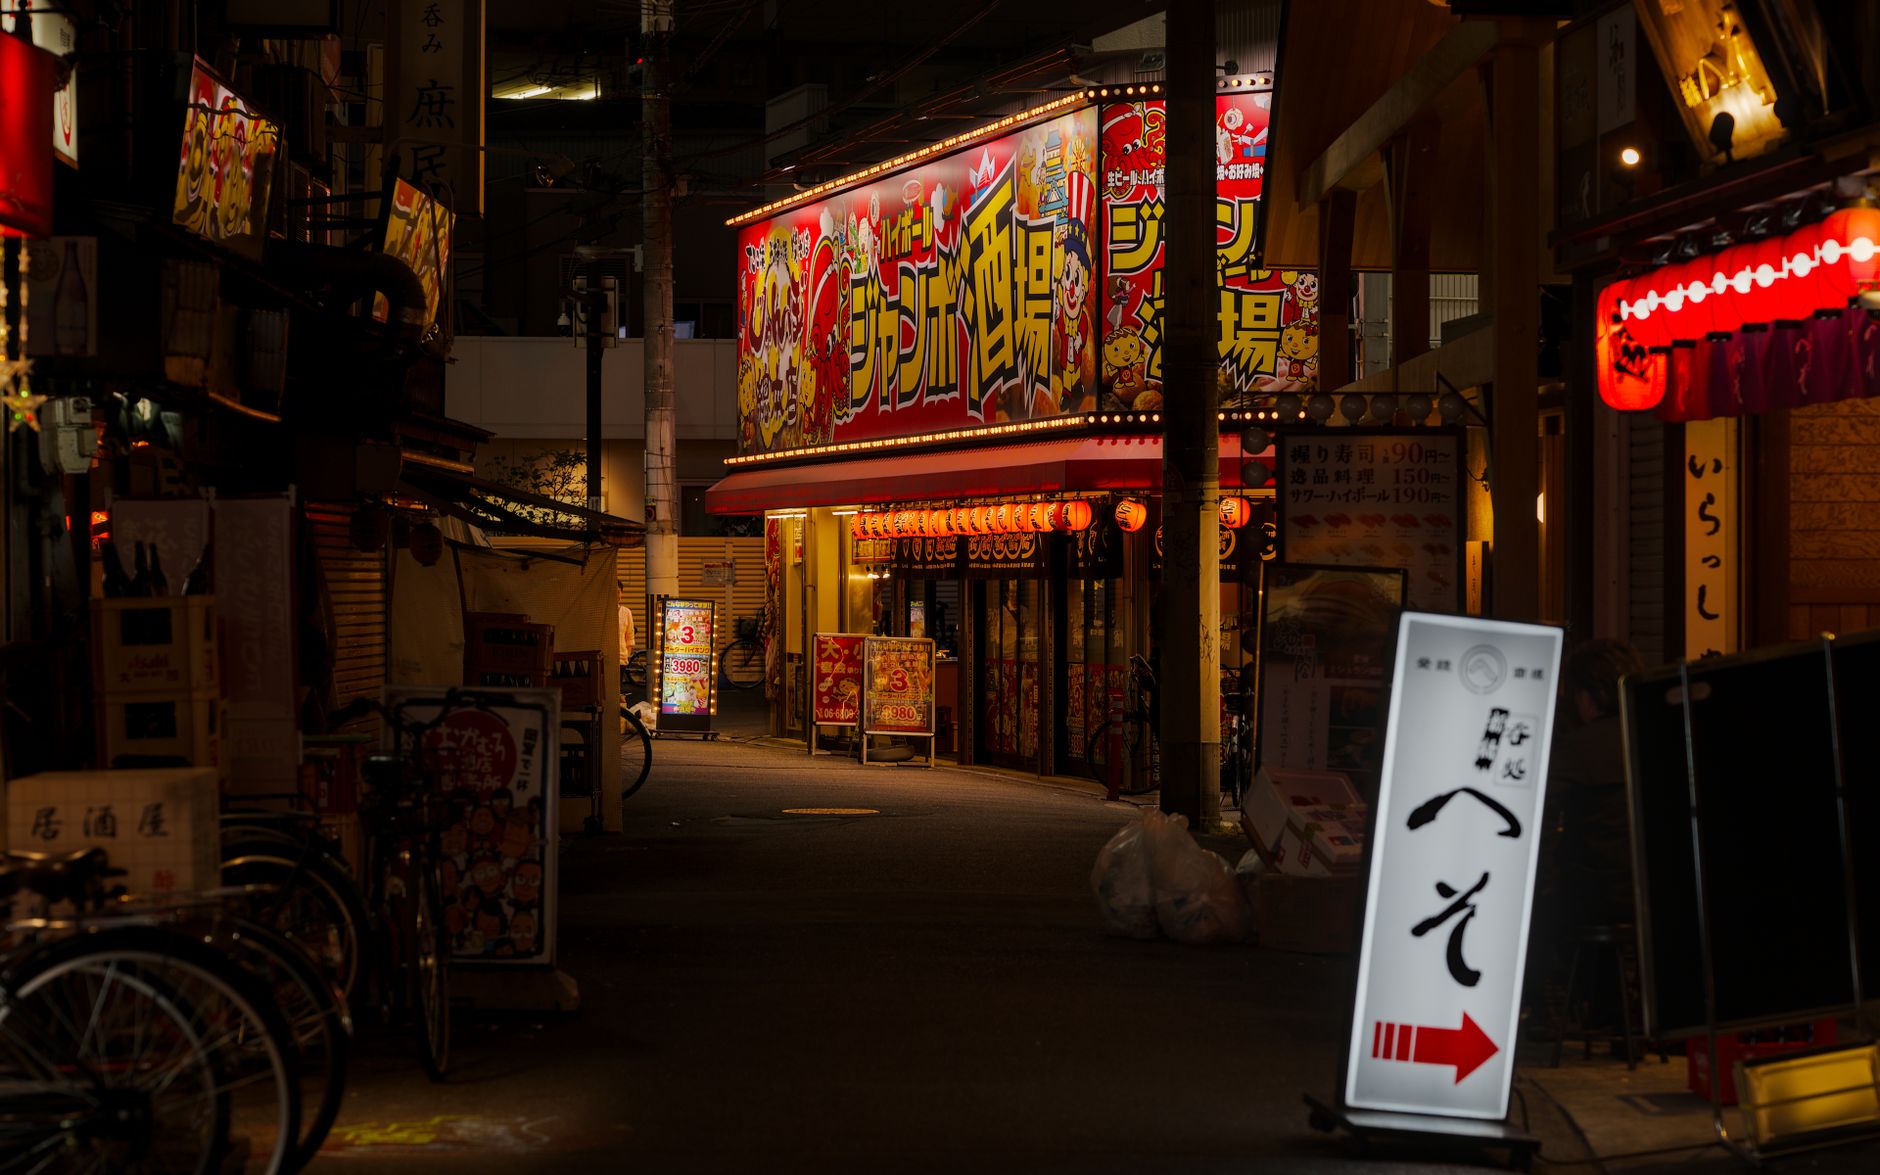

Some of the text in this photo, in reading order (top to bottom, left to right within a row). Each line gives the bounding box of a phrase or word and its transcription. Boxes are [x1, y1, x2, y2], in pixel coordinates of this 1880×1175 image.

[421, 2, 445, 54] 呑み
[880, 204, 934, 263] ハイボール
[850, 170, 1058, 412] ジャンボ酒場
[1290, 443, 1375, 465] 握り寿司
[1289, 467, 1375, 485] 逸品料理
[1289, 486, 1390, 503] サワー・ハイボール
[1688, 453, 1723, 658] いらっし
[680, 625, 695, 644] 3
[672, 659, 701, 673] 3980
[890, 668, 909, 692] 3
[881, 705, 916, 721] 3980
[31, 802, 170, 841] 居酒屋
[1405, 787, 1522, 989] へそ
